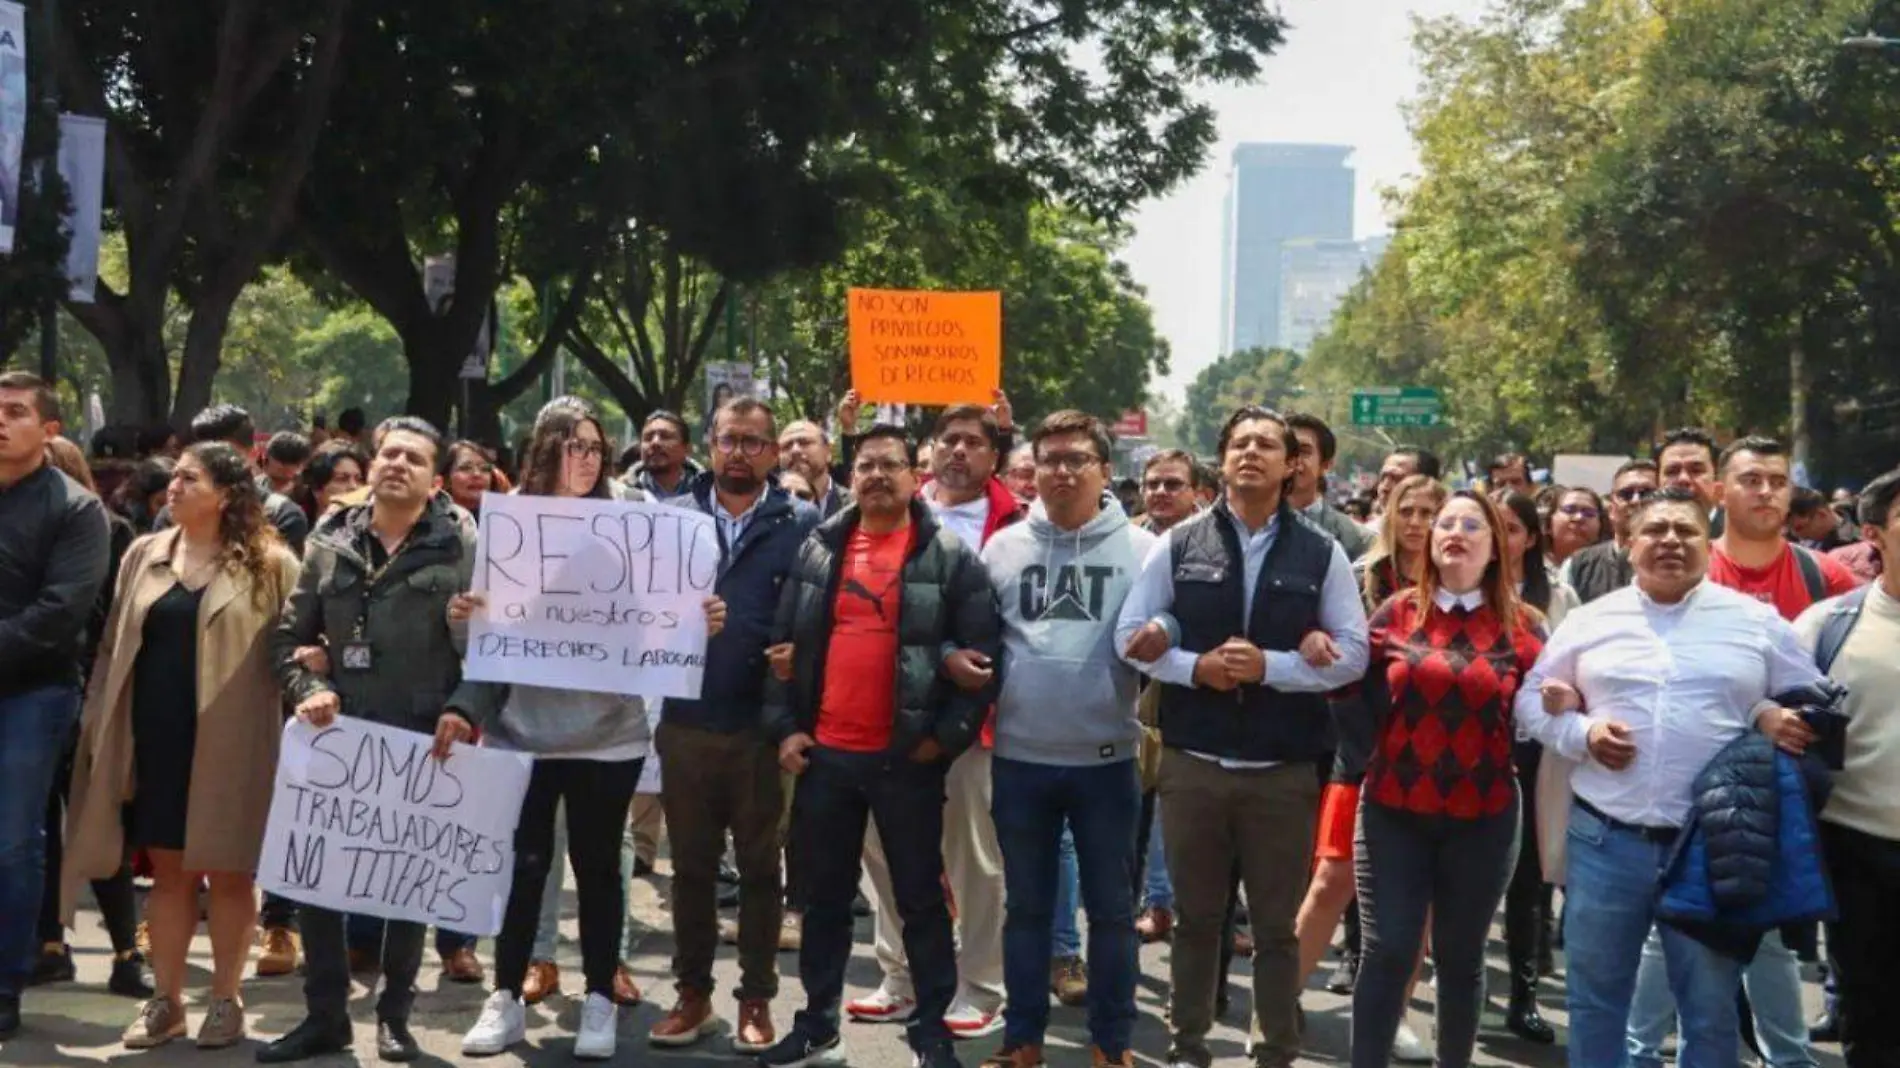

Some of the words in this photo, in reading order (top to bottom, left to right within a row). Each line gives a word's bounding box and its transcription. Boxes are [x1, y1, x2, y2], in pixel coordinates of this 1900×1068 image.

[858, 295, 884, 312] NO
[890, 295, 929, 314] SON
[484, 511, 716, 596] RESPETO
[505, 603, 527, 621] a
[546, 601, 679, 630] nuestros
[1020, 563, 1114, 621] CAT
[477, 632, 609, 662] DERECHOS
[309, 727, 463, 808] SOMOS
[286, 783, 508, 875] TRABAJADORES
[283, 830, 326, 889] NO
[341, 846, 468, 923] TITERES
